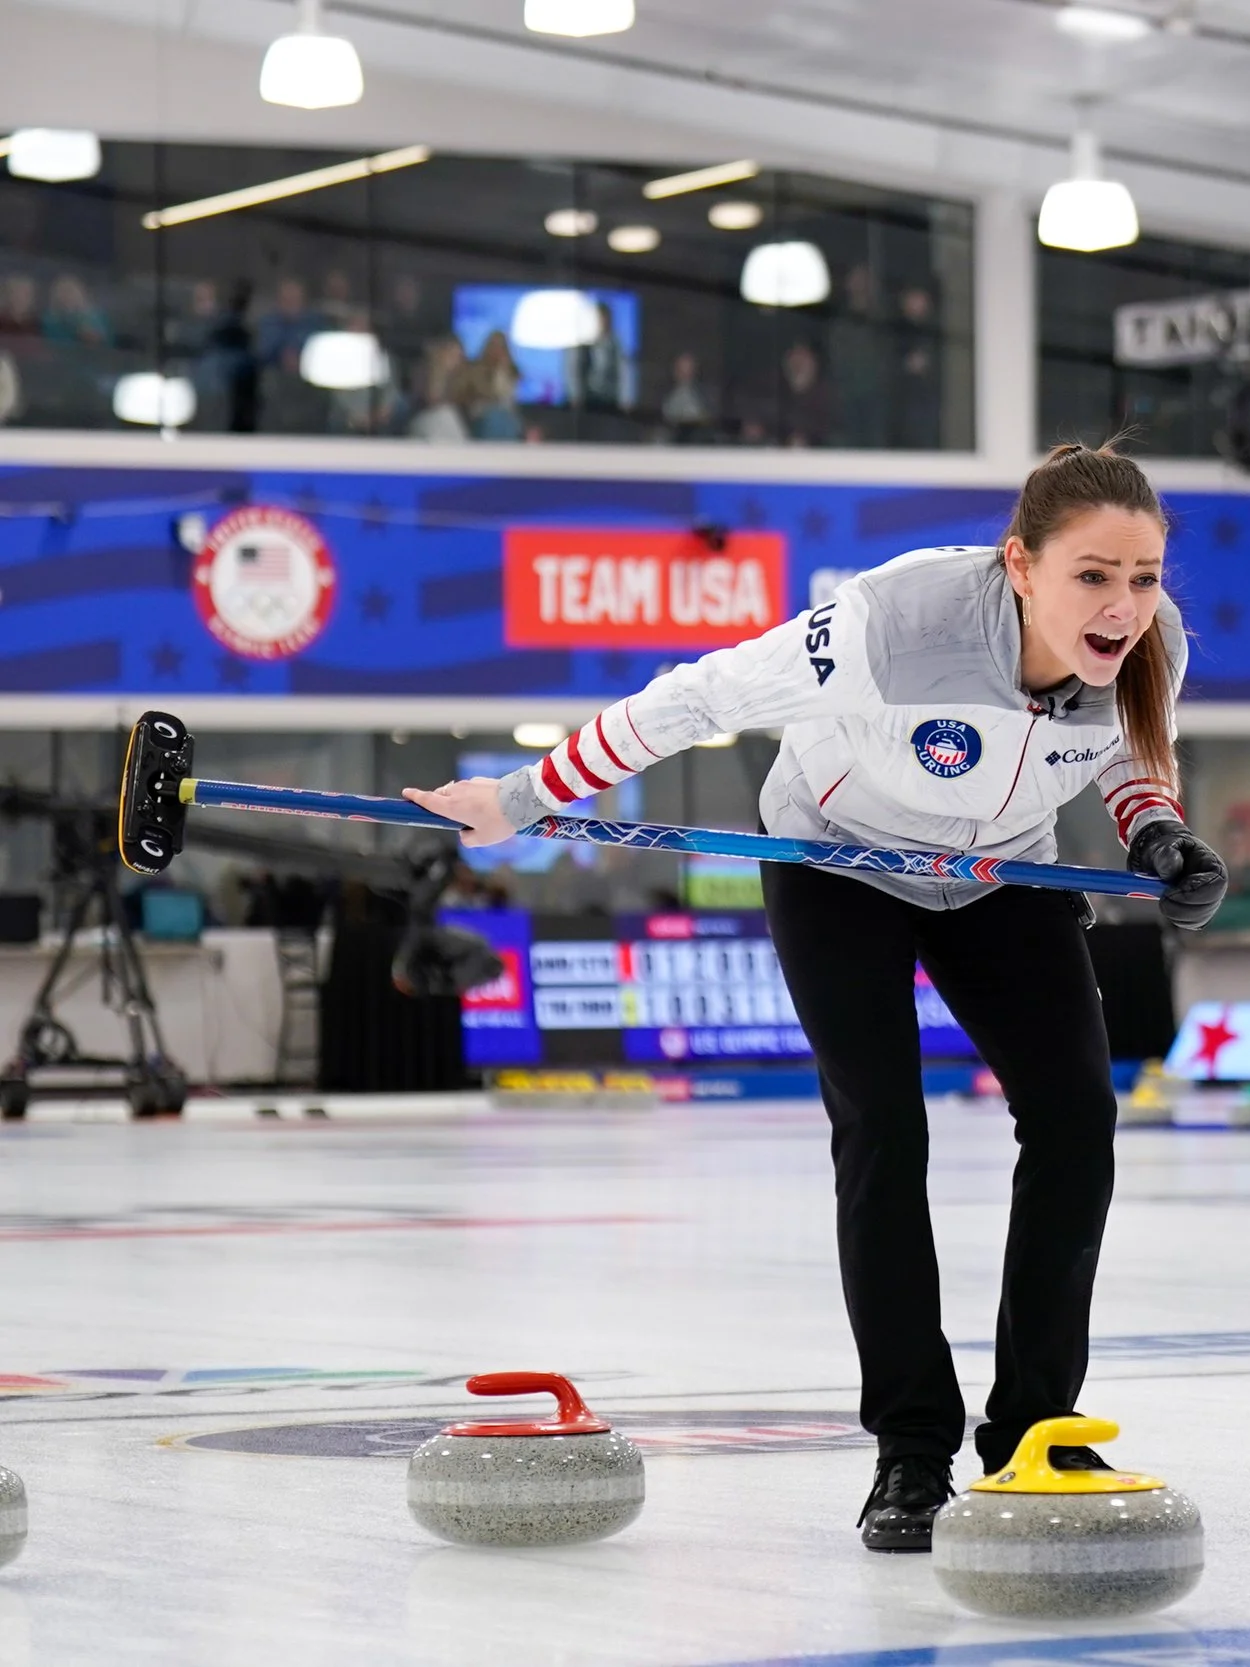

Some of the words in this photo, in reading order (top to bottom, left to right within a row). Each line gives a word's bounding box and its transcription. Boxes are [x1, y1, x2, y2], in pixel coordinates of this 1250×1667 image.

[533, 555, 662, 626] TEAM
[669, 556, 770, 628] USA
[805, 602, 837, 687] USA
[936, 720, 967, 732] USA
[917, 745, 971, 777] URLING
[1062, 734, 1121, 764] Colu
